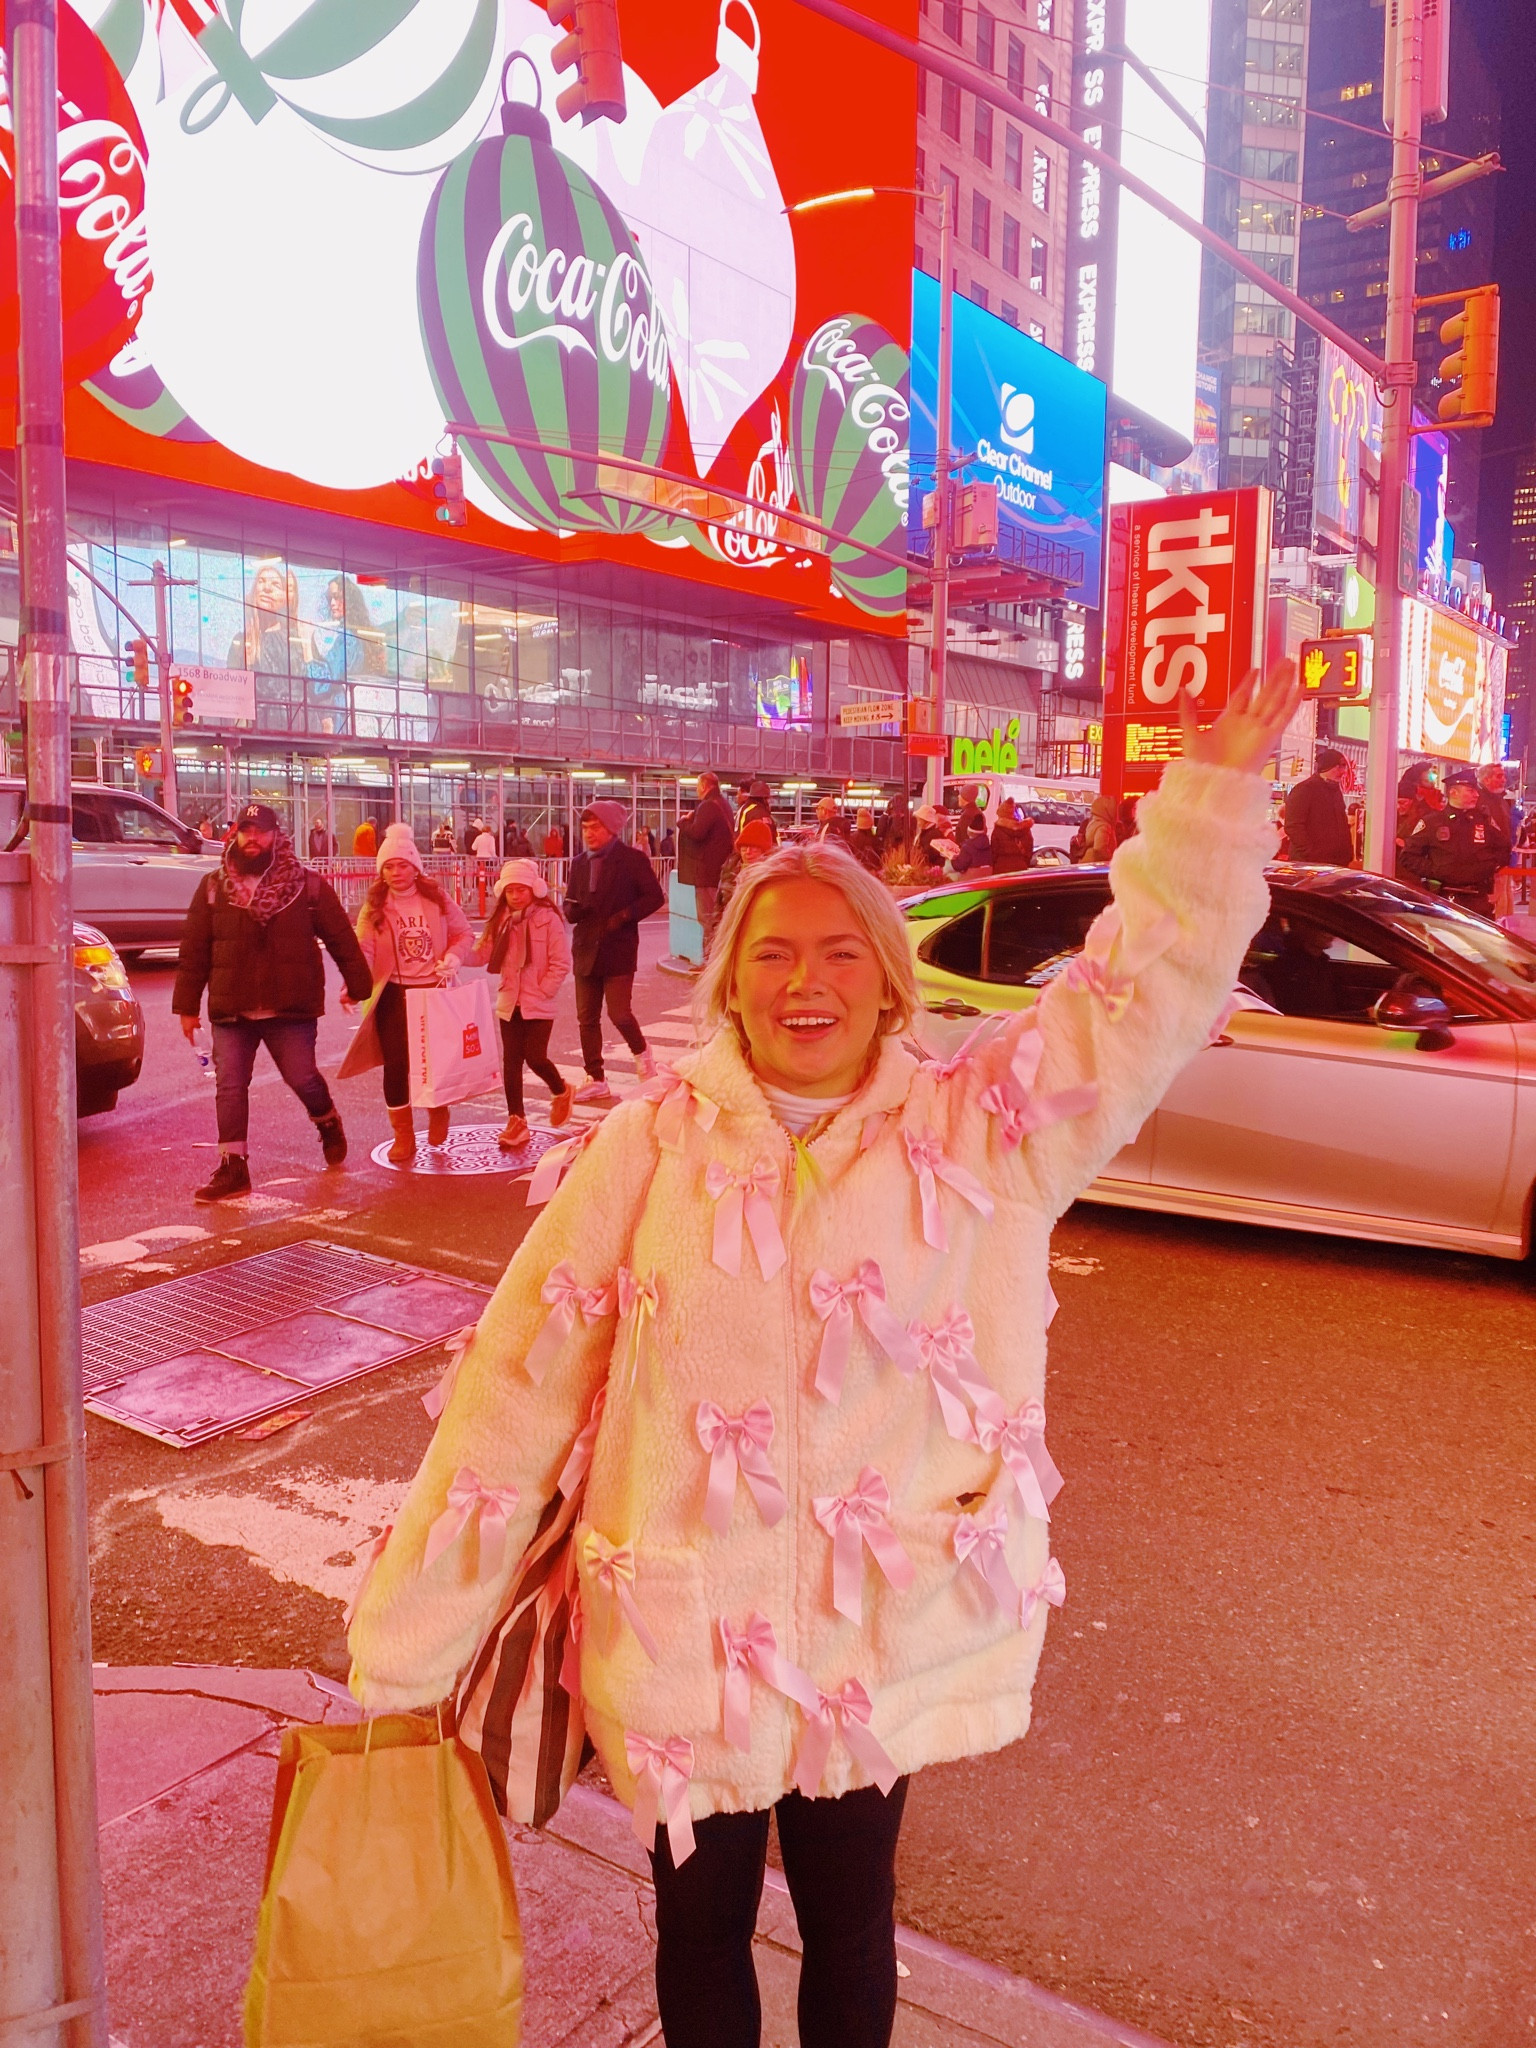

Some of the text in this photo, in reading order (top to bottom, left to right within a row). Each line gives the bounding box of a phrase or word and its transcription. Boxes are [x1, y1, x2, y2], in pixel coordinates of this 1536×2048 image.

[483, 213, 669, 392] Coca-Cola
[1076, 264, 1098, 372] EXPRESS
[978, 438, 1053, 491] Clear Channel
[1133, 533, 1141, 568] service
[1132, 571, 1141, 581] of
[1131, 583, 1141, 617] theatre
[1141, 508, 1234, 705] tkts
[1128, 619, 1140, 681] development
[178, 667, 248, 685] 1568 Broadway
[1344, 650, 1357, 686] 3
[1127, 682, 1138, 705] fund
[396, 915, 430, 929] ARI
